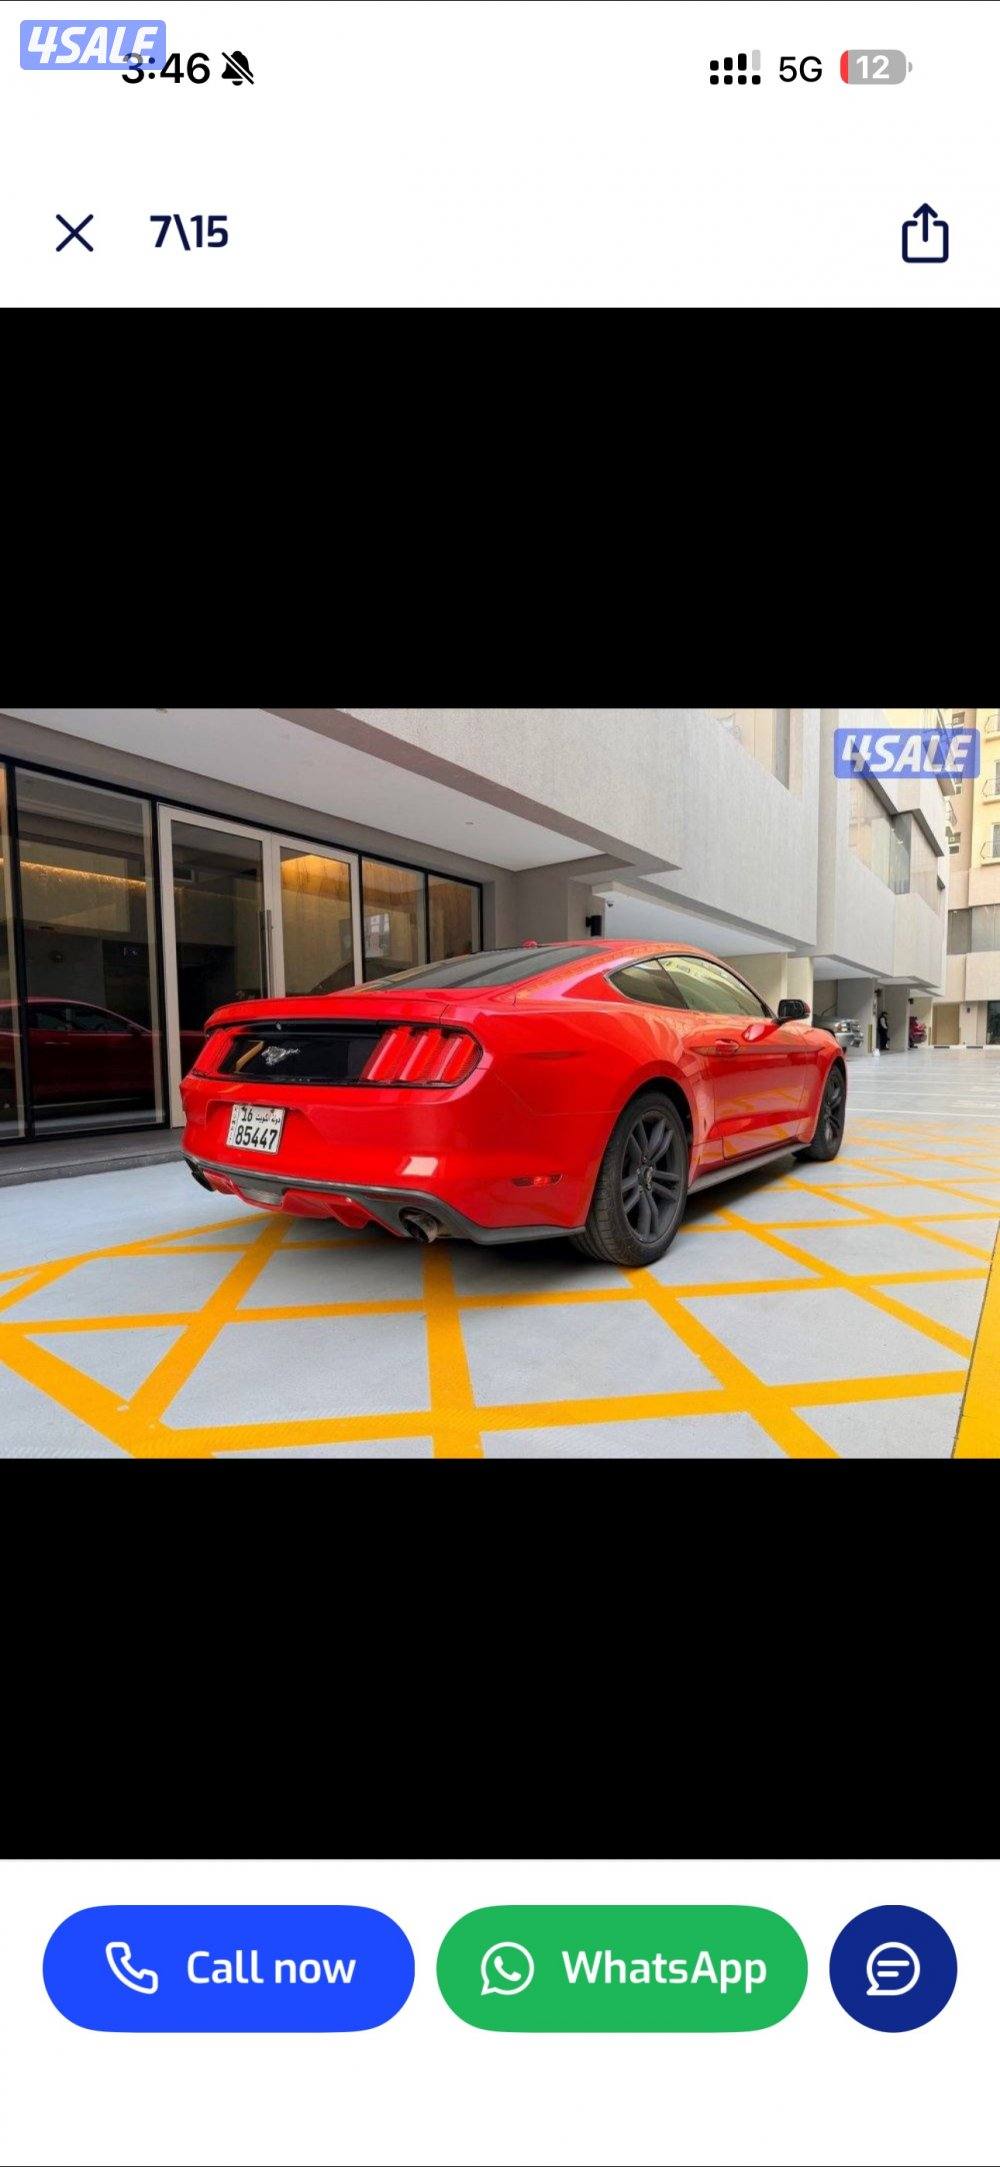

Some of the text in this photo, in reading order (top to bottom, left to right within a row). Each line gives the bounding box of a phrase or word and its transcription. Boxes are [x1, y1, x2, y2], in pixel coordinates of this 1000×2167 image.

[121, 53, 211, 85] 3:46
[779, 56, 823, 83] 5G
[856, 54, 890, 79] 12
[149, 214, 229, 251] 7\15
[242, 1108, 253, 1122] 16
[235, 1125, 278, 1150] 85447
[187, 1949, 357, 1984] Call now
[561, 1949, 768, 1994] WhatsApp
